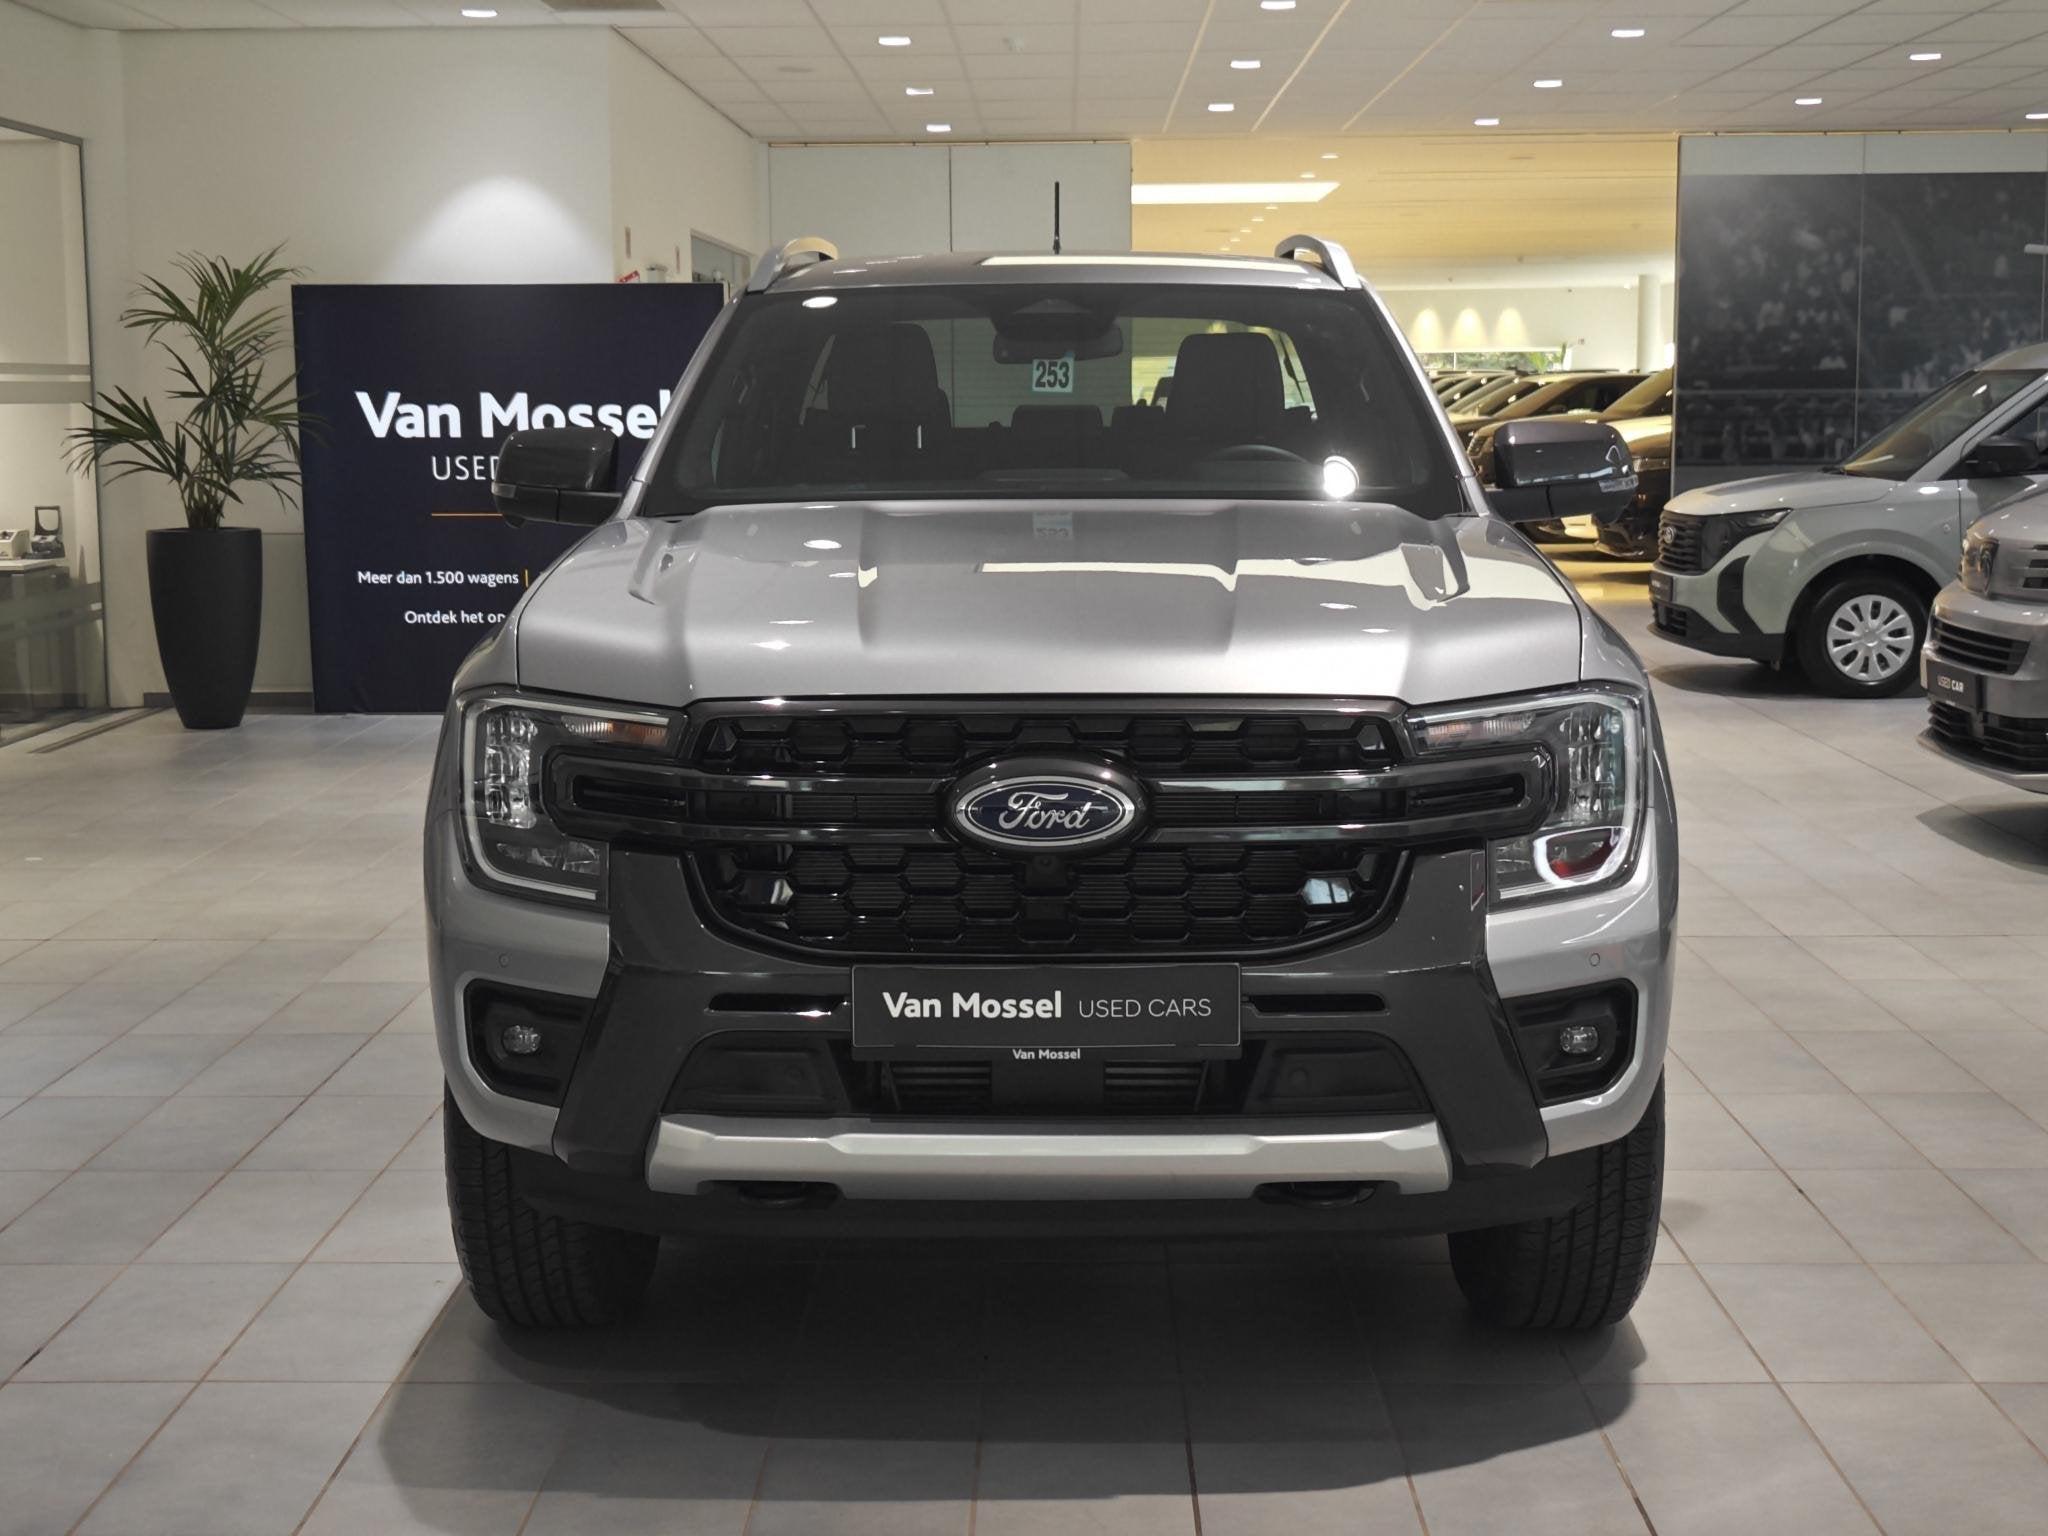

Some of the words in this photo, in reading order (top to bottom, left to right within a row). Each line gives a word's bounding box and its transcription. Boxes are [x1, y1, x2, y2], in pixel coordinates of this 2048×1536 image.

[1035, 361, 1070, 388] 253
[354, 391, 462, 439] Van
[357, 570, 393, 584] Meer
[396, 570, 422, 585] dan
[425, 570, 464, 585] 1.500
[467, 572, 519, 588] wagens
[404, 610, 458, 624] Ontdek
[460, 609, 484, 624] het
[1951, 679, 1964, 693] CAR
[999, 791, 1091, 829] Ford
[882, 991, 942, 1018] Van
[952, 990, 1062, 1019] Mossel
[1079, 999, 1142, 1018] USED
[1148, 998, 1212, 1017] CARS
[1012, 1048, 1036, 1060] Van
[1038, 1047, 1081, 1060] Mossel
